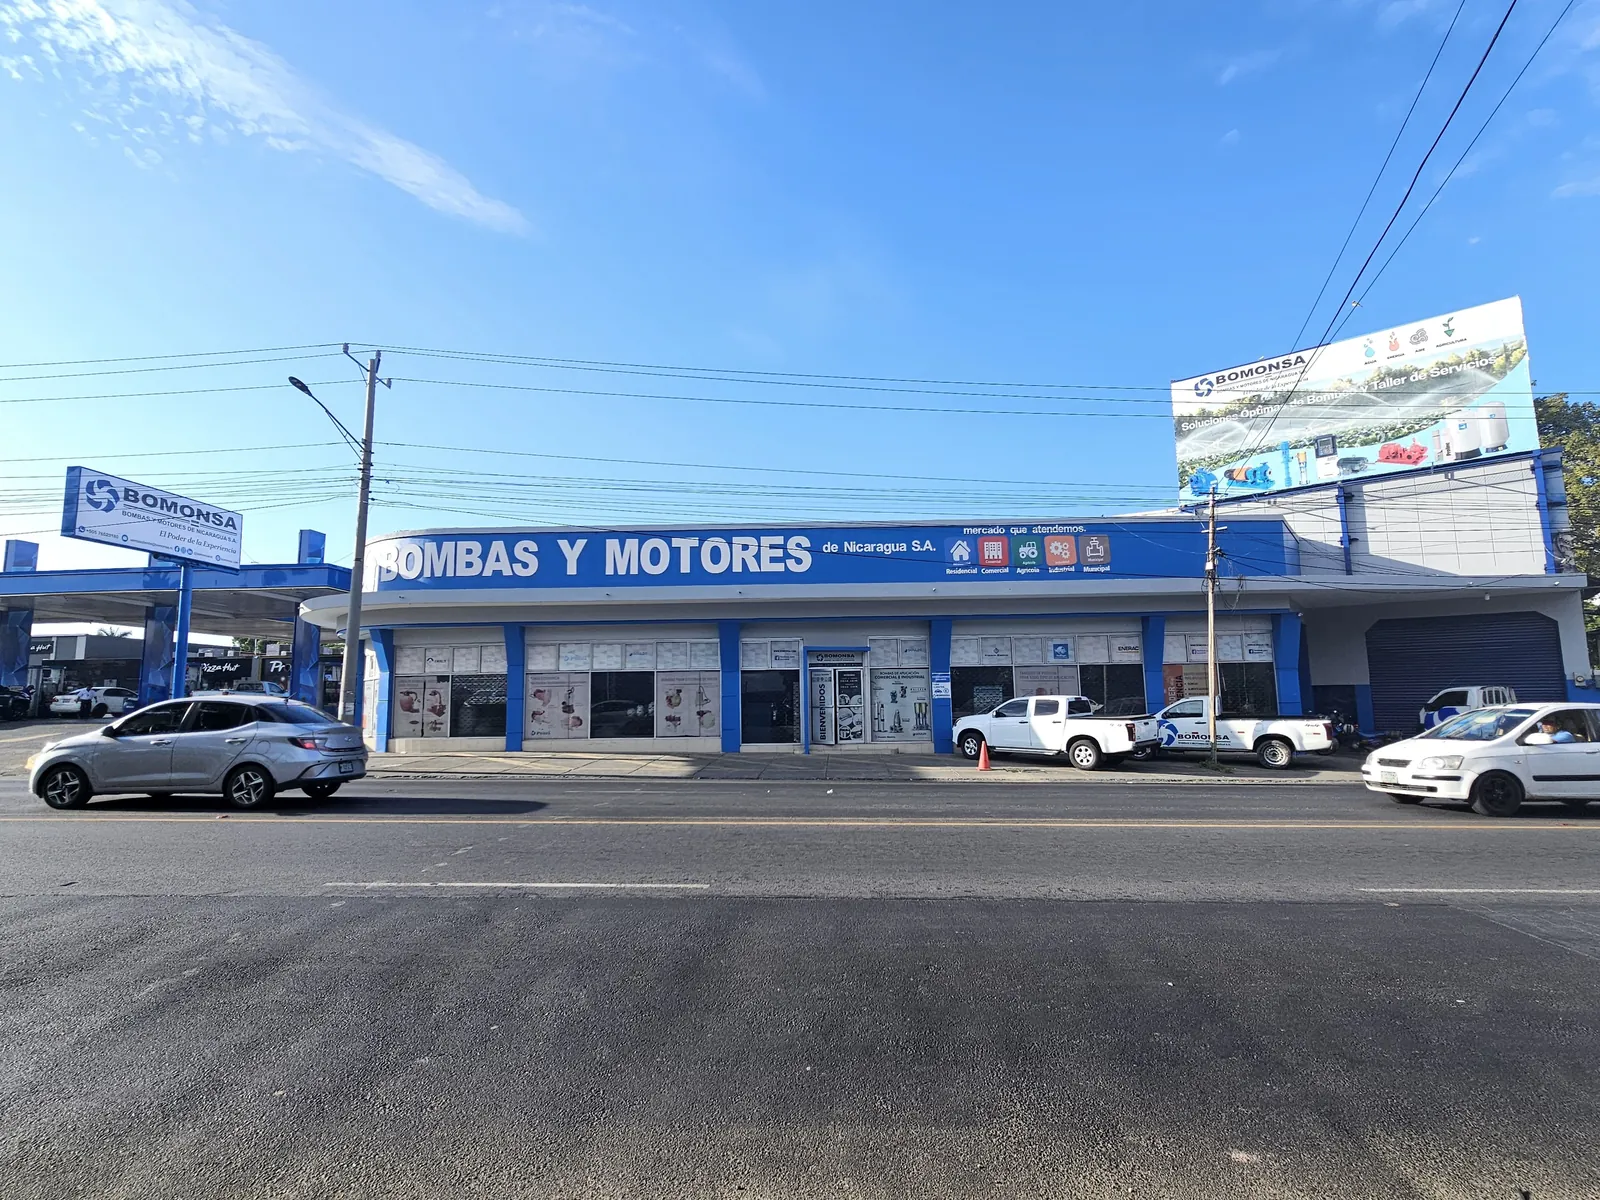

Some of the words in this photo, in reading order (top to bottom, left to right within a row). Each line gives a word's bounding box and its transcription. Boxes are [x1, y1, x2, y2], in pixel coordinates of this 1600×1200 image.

[1216, 355, 1306, 384] BOMONSA
[1182, 413, 1238, 431] Soluciones
[1371, 376, 1407, 390] Taller
[1410, 372, 1426, 382] de
[1429, 356, 1496, 378] Servicios
[124, 487, 237, 531] BOMONSA
[167, 532, 186, 541] Poder
[188, 536, 195, 544] de
[203, 541, 237, 554] Experiencia
[963, 526, 1005, 535] mercado
[1010, 527, 1027, 535] que
[380, 539, 539, 582] BOMBAS
[557, 539, 588, 575] Y
[605, 536, 812, 575] MOTORES
[822, 542, 838, 553] de
[844, 541, 907, 554] Nicaragua
[912, 540, 936, 552] S.A.
[222, 663, 240, 672] Hut
[819, 684, 827, 740] BIENVENIDOS
